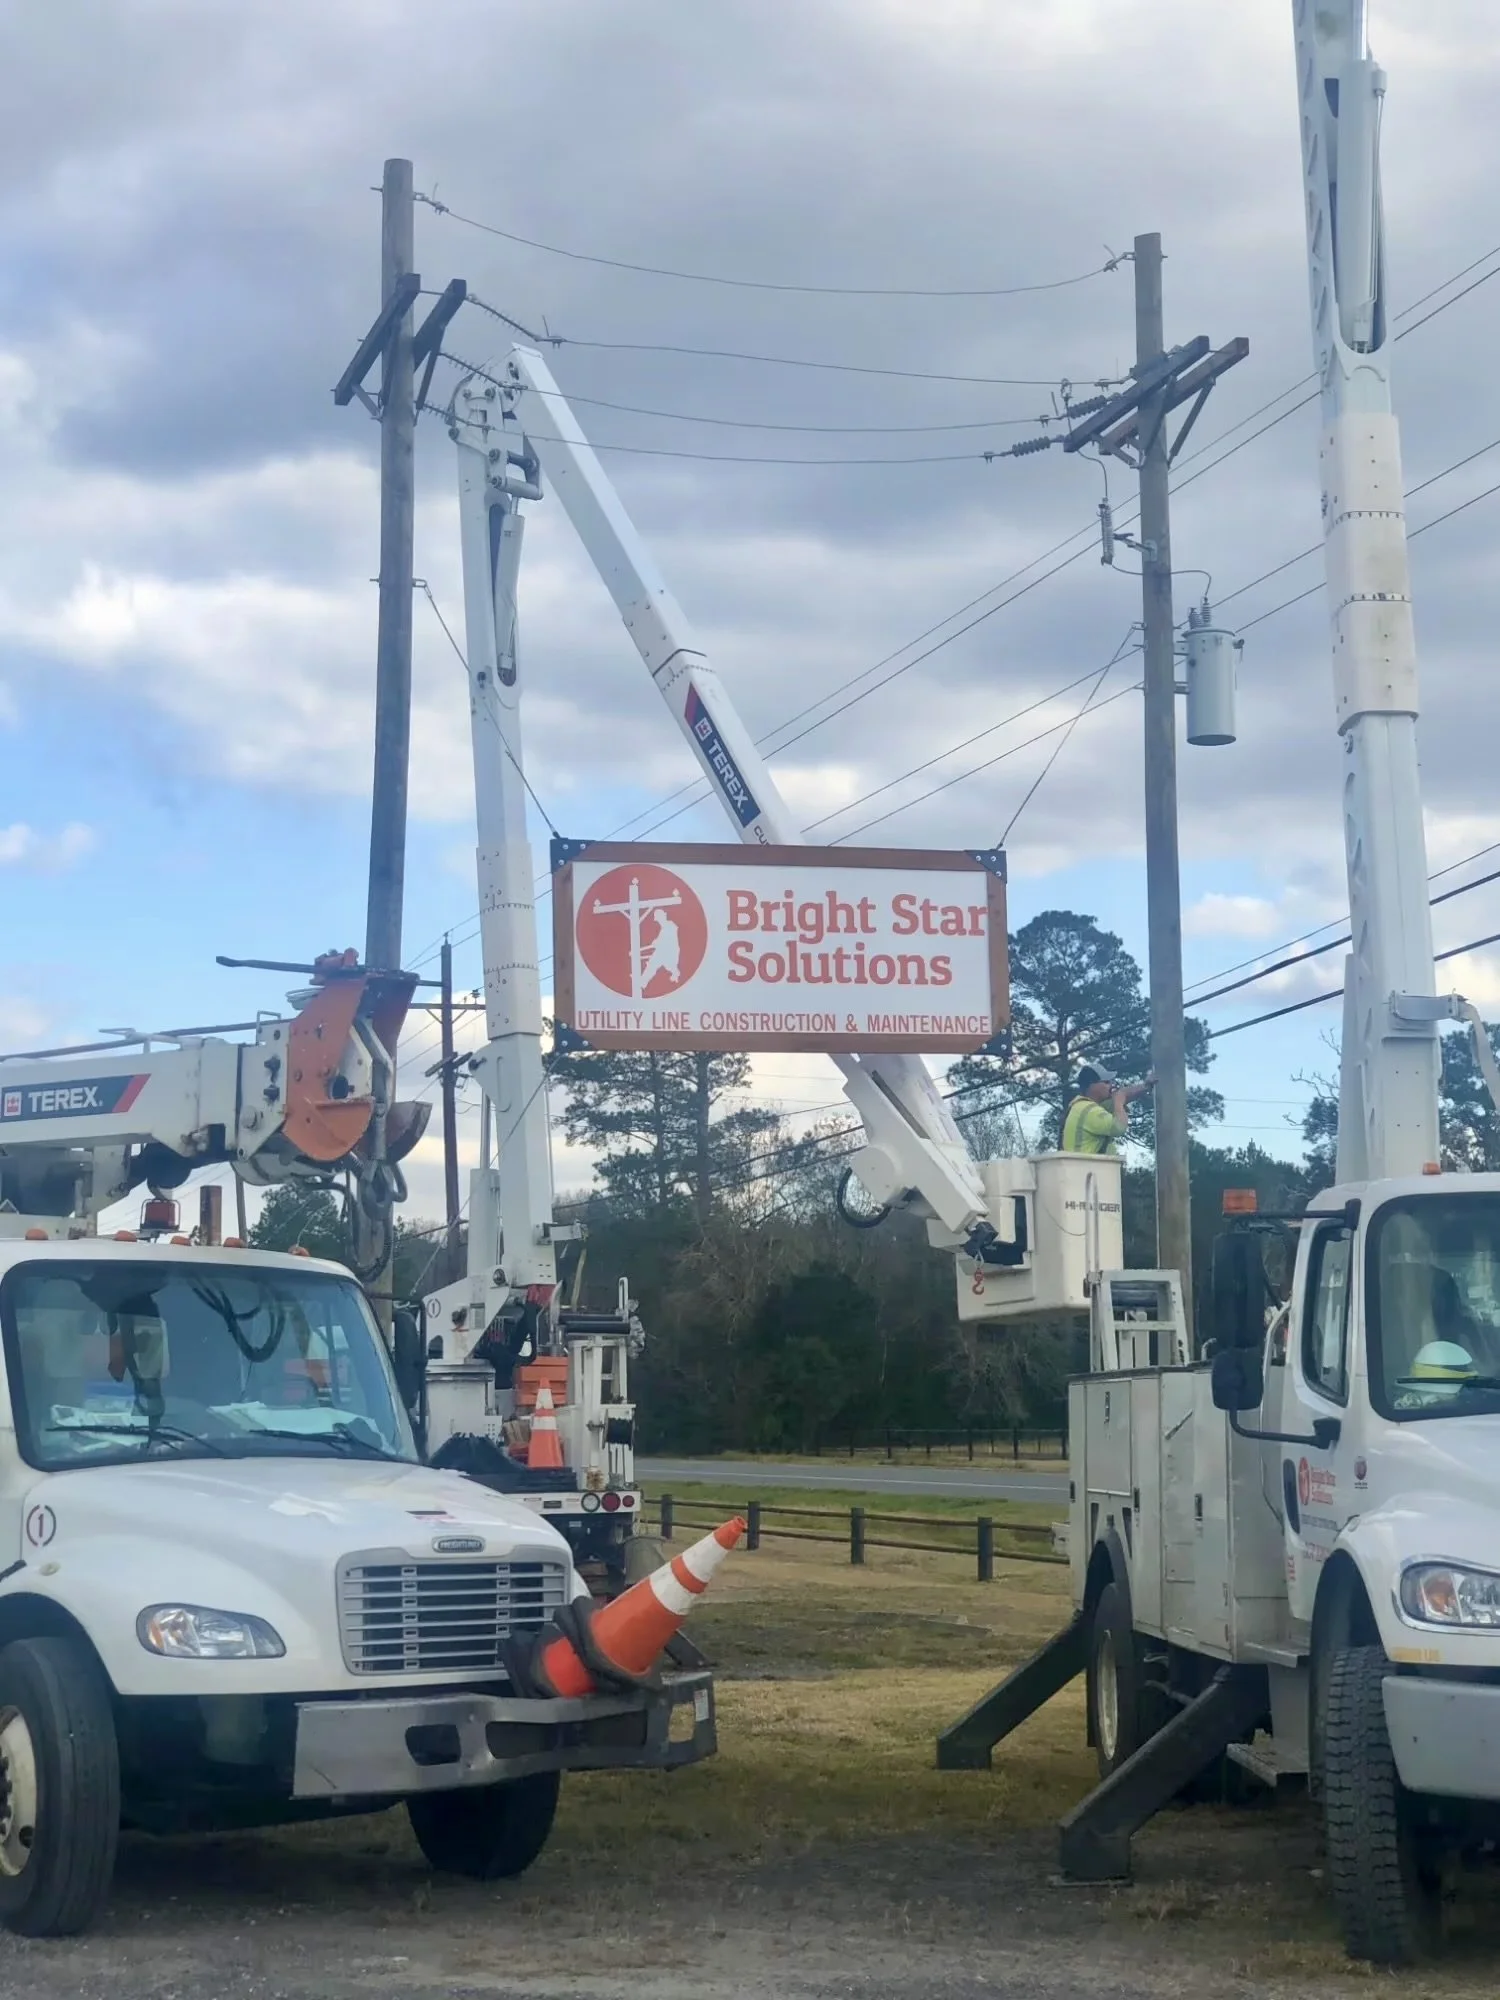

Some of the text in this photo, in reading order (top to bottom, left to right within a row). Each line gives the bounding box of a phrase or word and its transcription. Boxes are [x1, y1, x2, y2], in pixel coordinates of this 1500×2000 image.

[708, 738, 749, 809] TEREX
[726, 889, 988, 944] Bright Star
[727, 940, 953, 986] Solutions
[578, 1010, 989, 1034] UTILITY LINE CONSTRUCTION & MAINTENANCE
[28, 1086, 98, 1112] TEREX
